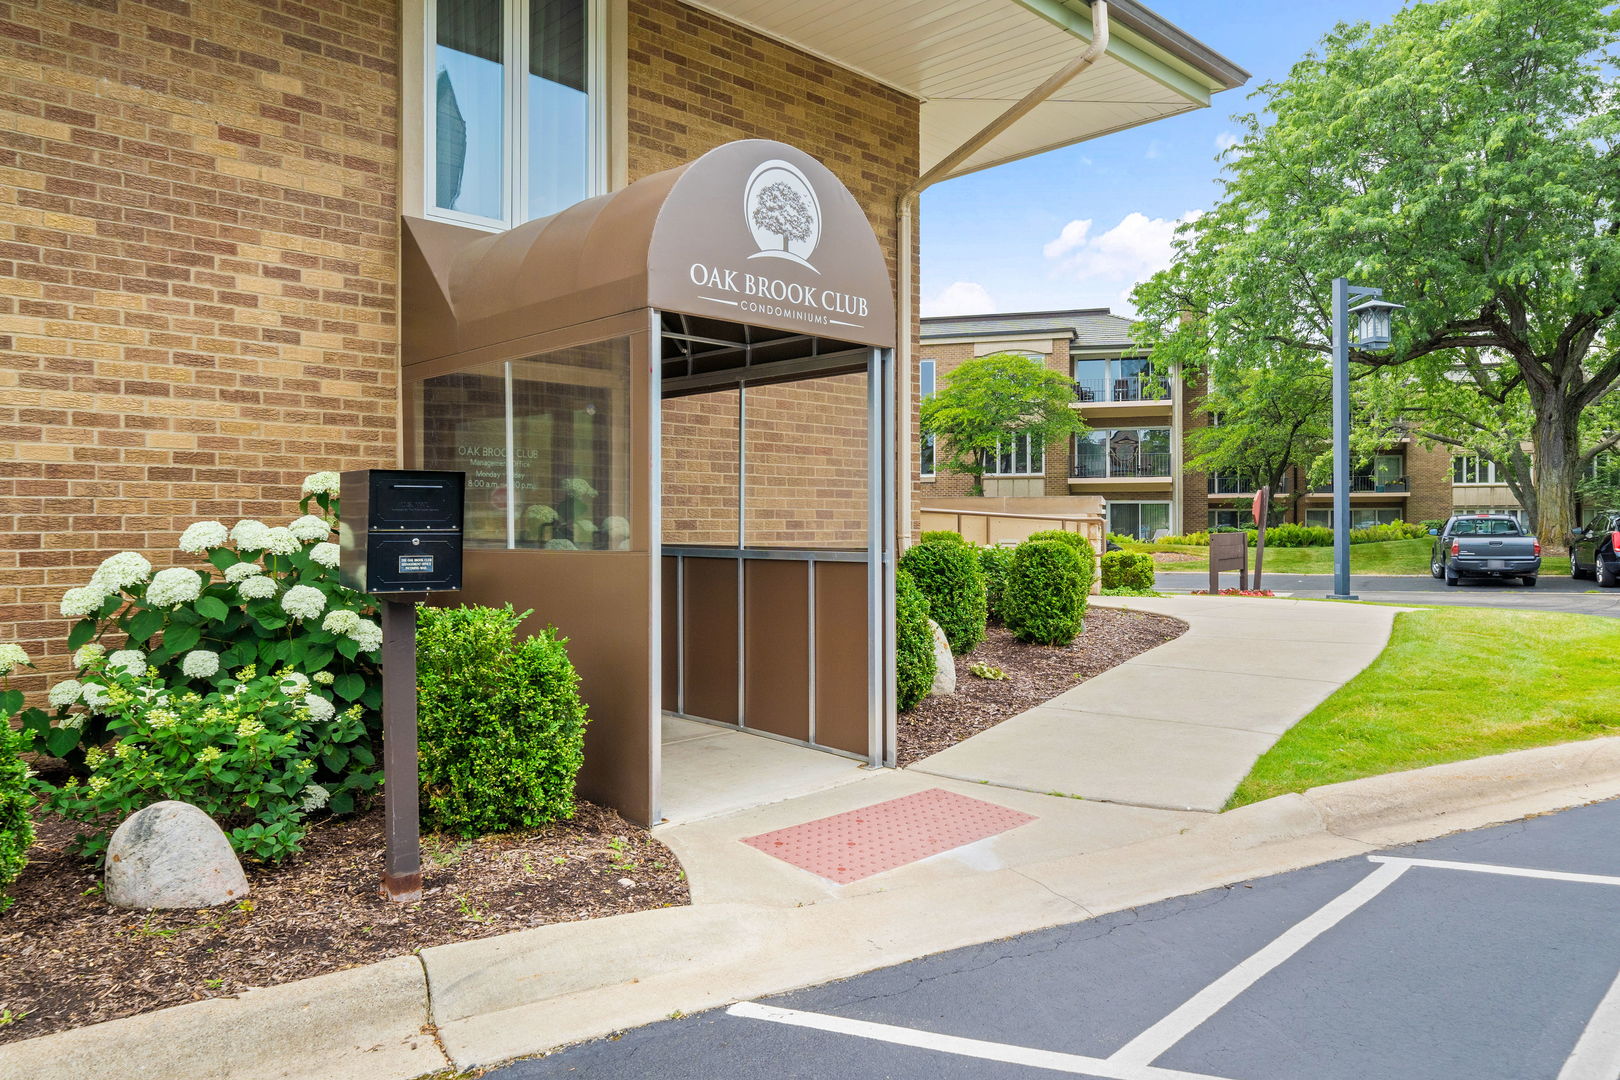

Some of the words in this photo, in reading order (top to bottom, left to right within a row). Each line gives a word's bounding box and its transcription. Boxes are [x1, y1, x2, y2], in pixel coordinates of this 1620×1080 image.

[690, 264, 740, 293] OAK
[744, 274, 818, 308] BROOK
[822, 290, 869, 317] CLUB
[740, 300, 828, 325] CONDOMINIUMS
[458, 446, 480, 456] OAK
[482, 447, 507, 458] BROO
[516, 448, 538, 458] CLUB
[470, 458, 506, 468] Managemen
[476, 470, 501, 479] Monday
[468, 480, 484, 488] 8:00
